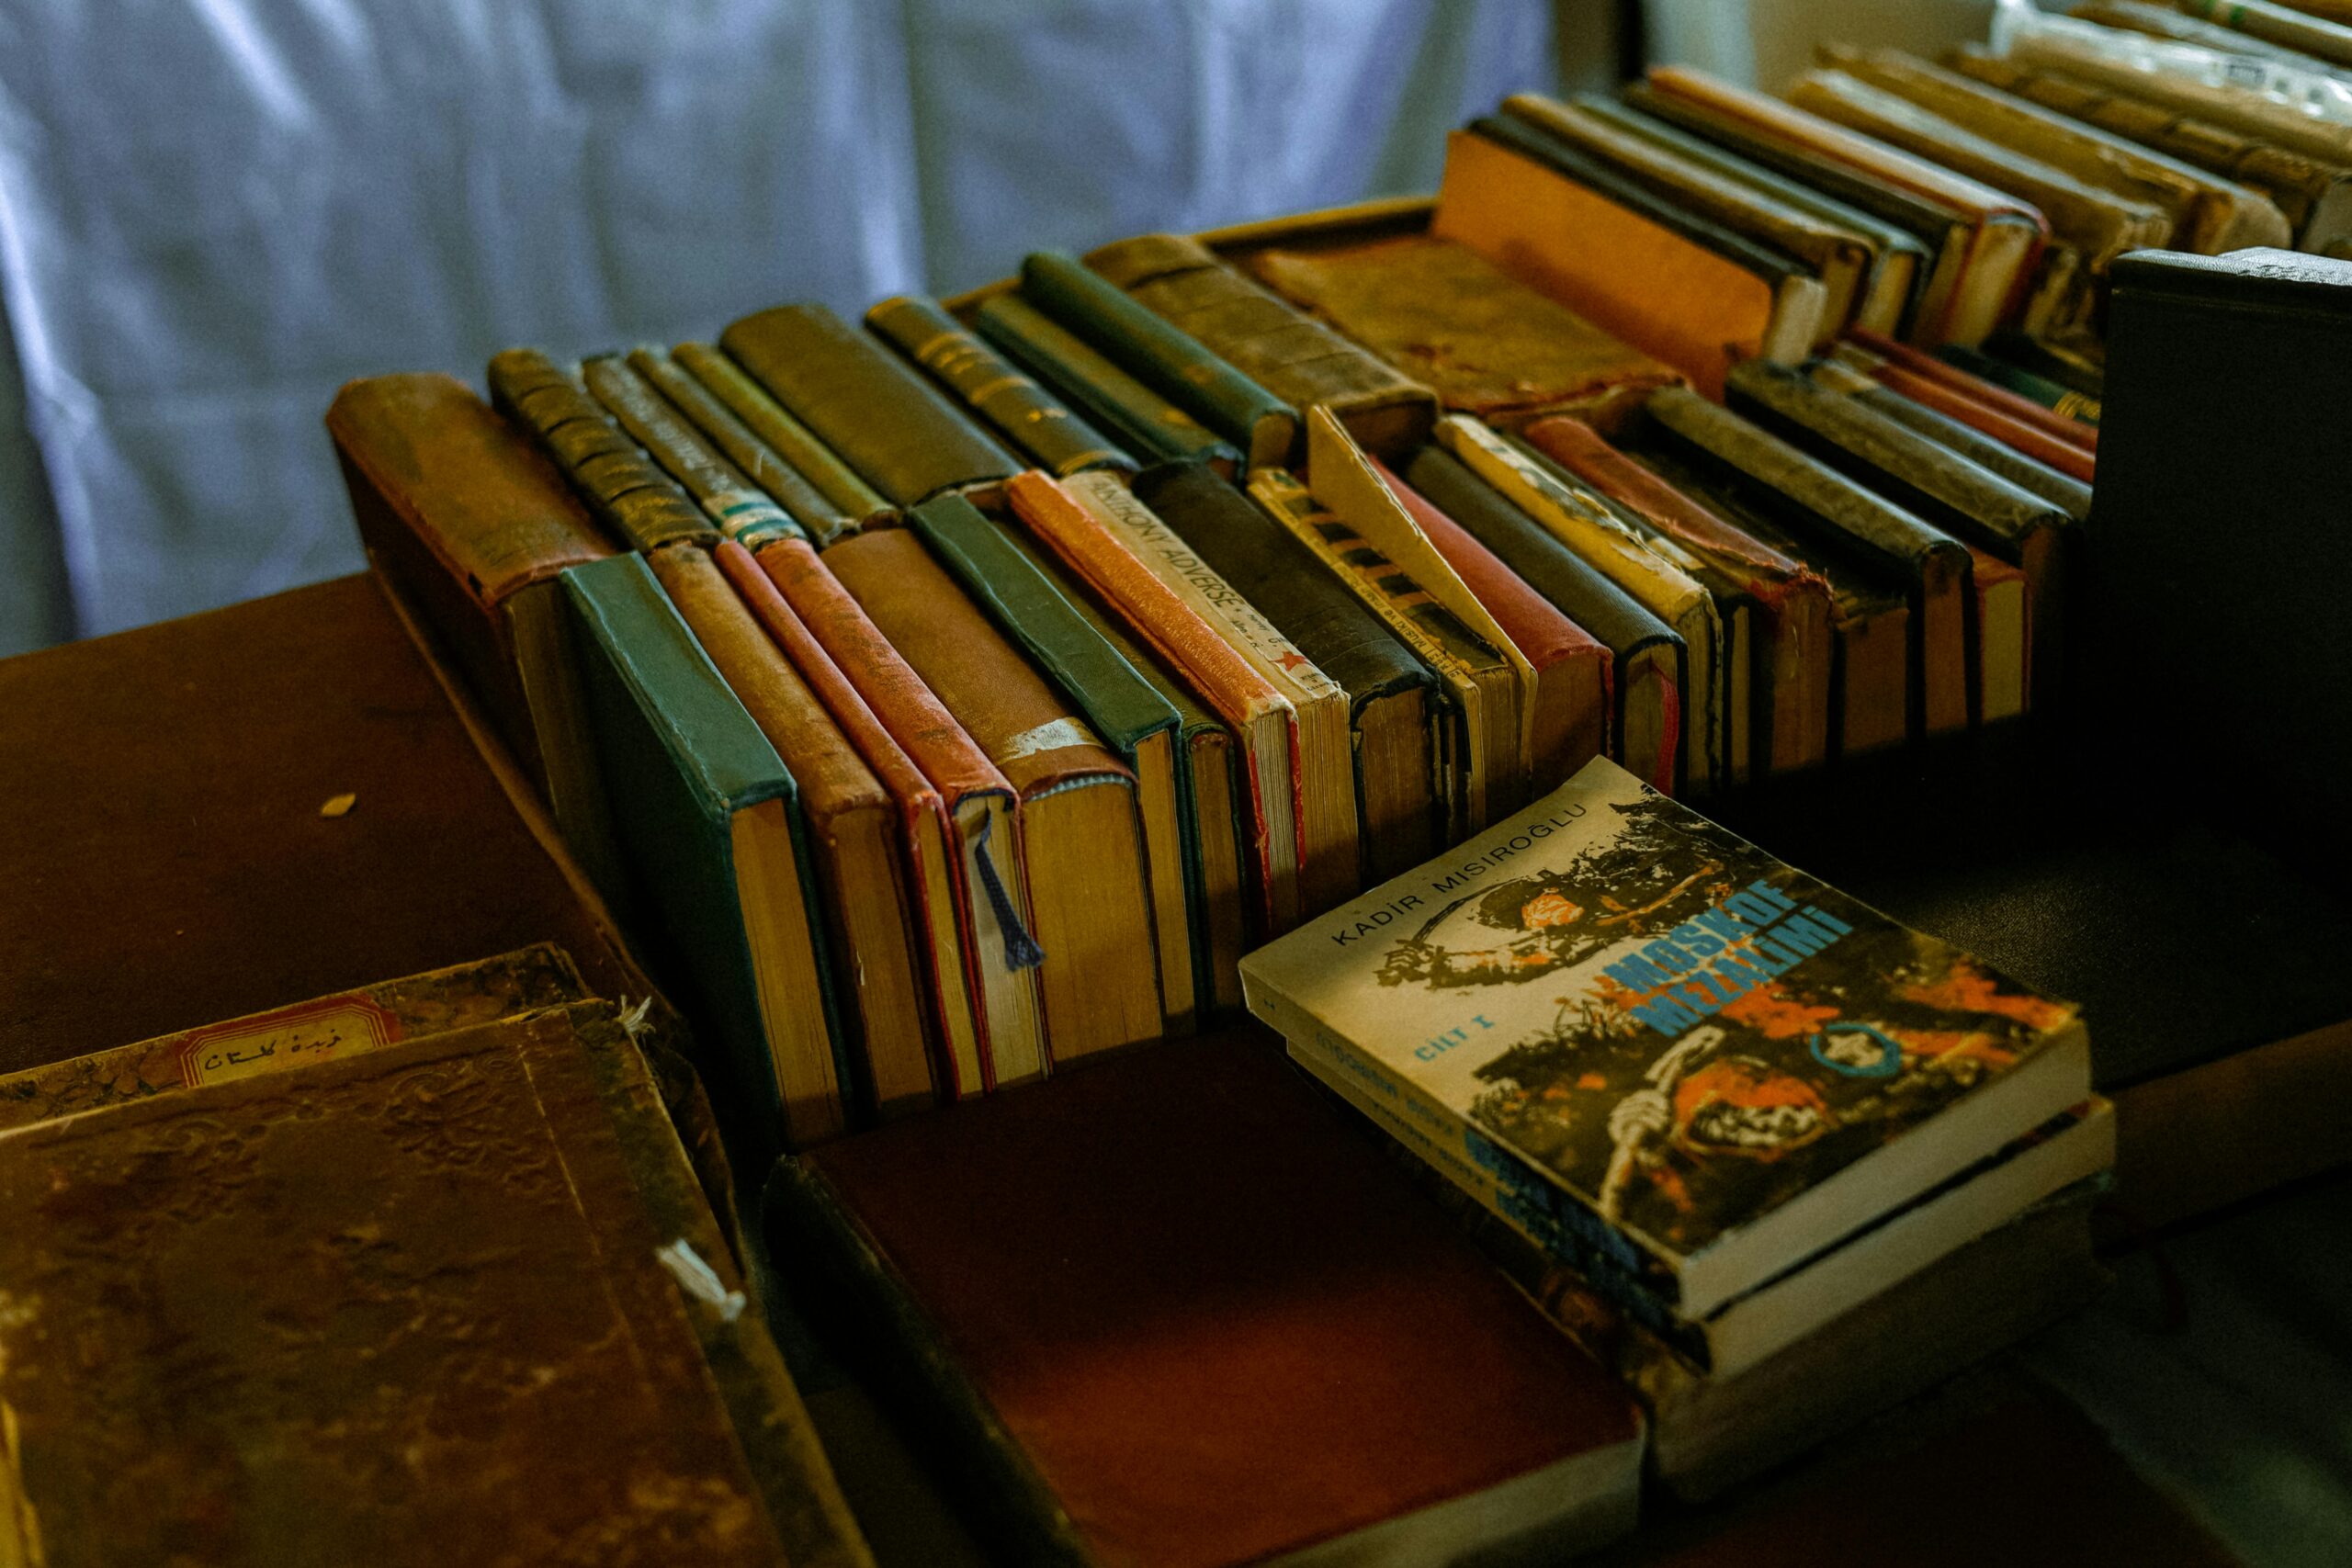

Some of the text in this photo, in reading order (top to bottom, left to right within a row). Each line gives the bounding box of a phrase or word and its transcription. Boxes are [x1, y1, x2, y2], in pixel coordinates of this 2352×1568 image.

[1159, 548, 1245, 608] ADVERSE
[1331, 803, 1587, 946] KADİR MISIROĞLU
[1601, 879, 1798, 994] MOSKOF
[1630, 905, 1854, 1037] MEZALİMİ
